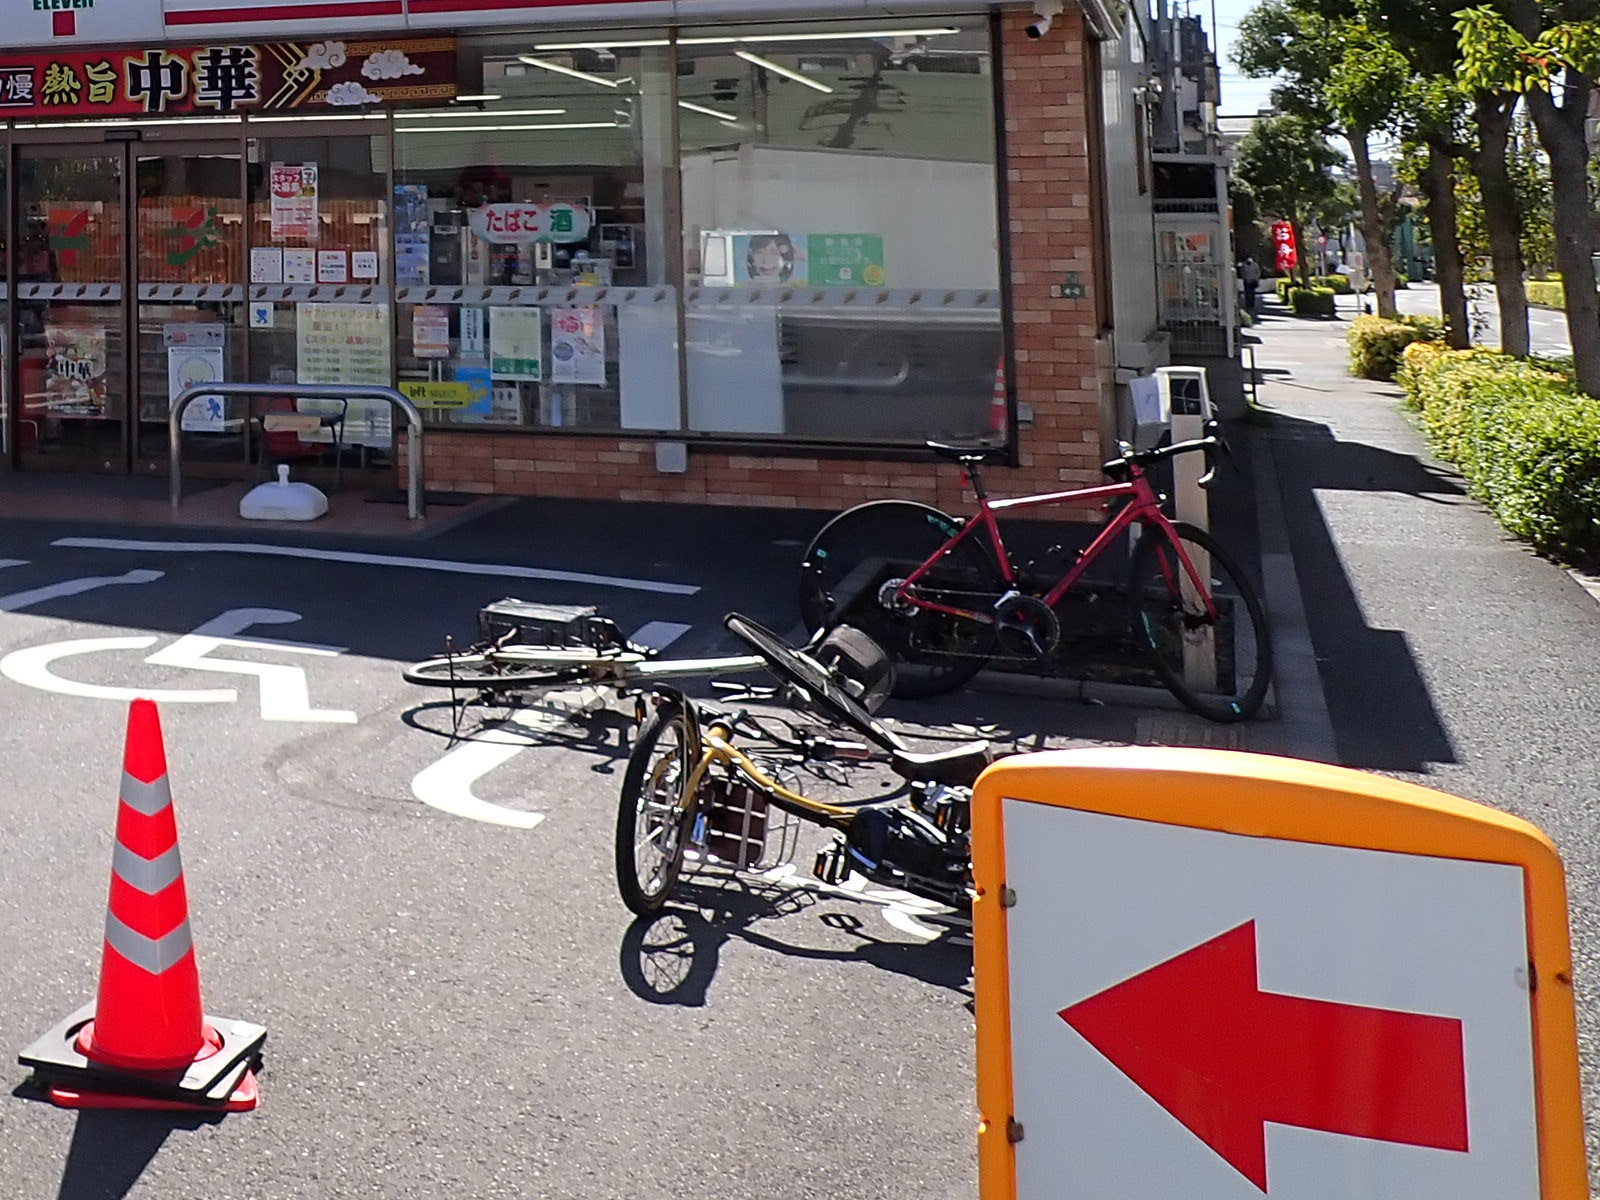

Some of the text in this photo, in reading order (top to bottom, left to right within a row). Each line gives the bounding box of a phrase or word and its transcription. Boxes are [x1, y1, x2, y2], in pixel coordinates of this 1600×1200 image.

[486, 209, 538, 232] たばこ
[550, 209, 573, 232] 酒
